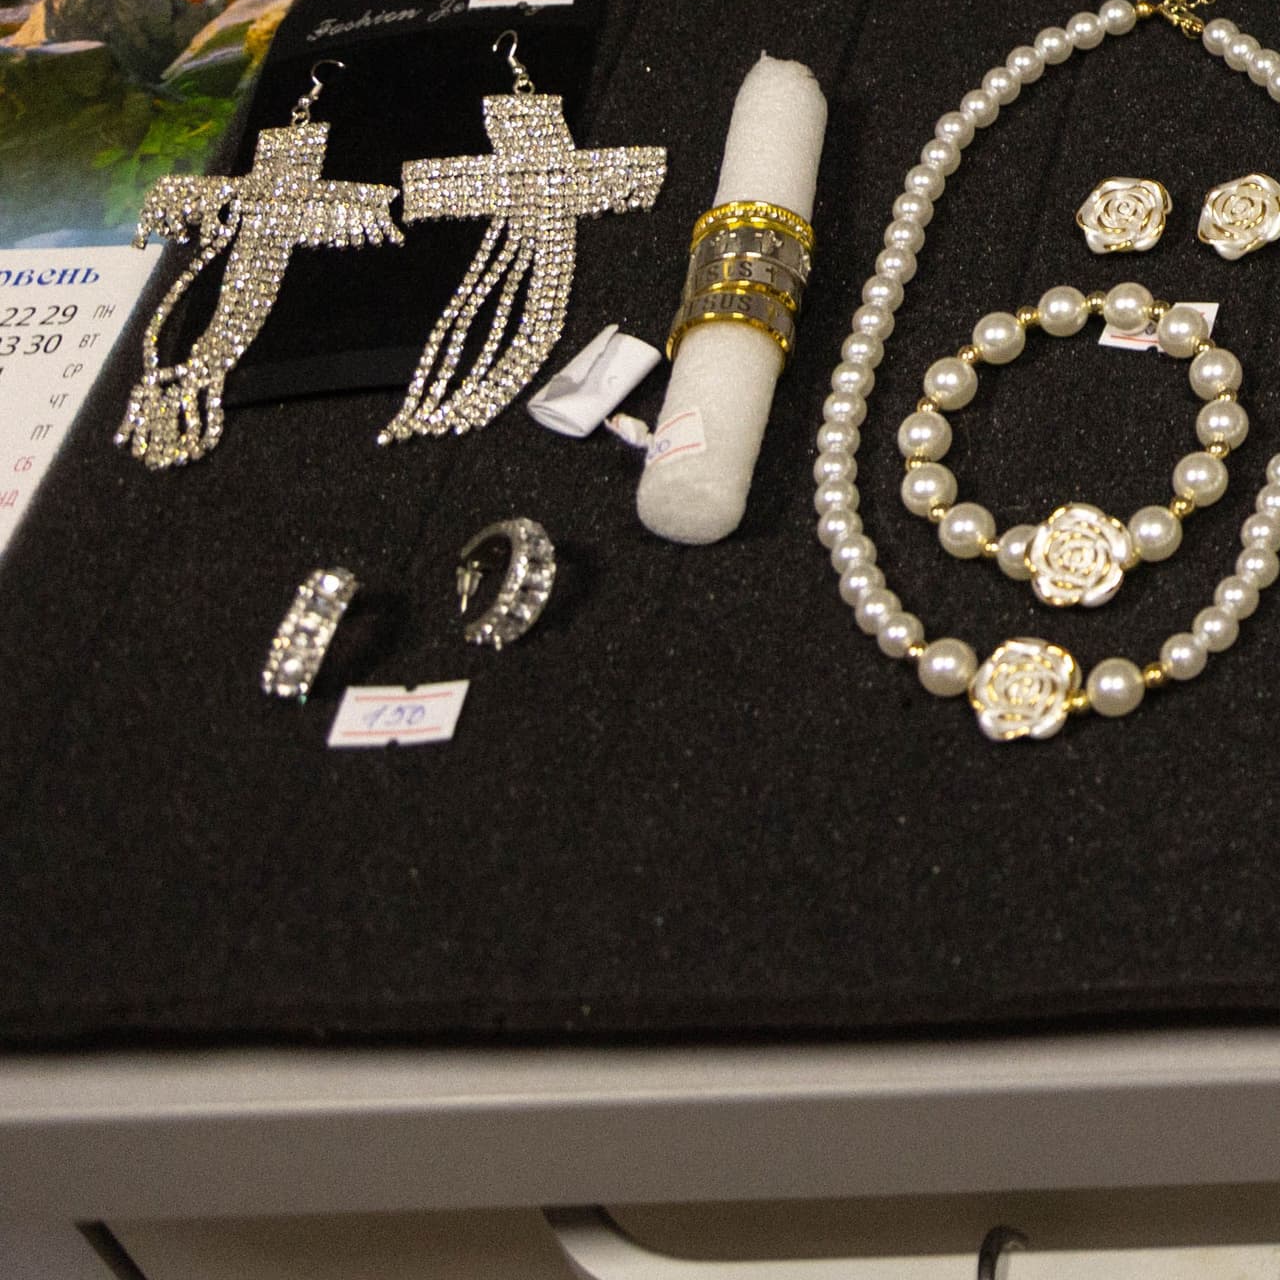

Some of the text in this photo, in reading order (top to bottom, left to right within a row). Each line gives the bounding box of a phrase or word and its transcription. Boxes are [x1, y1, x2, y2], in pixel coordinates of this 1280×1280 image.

[305, 6, 424, 43] Fashion
[693, 261, 754, 288] SUS
[38, 303, 79, 326] 29
[92, 303, 116, 320] ПН
[687, 293, 751, 317] SUS
[0, 332, 101, 357] 3 30 ВТ
[62, 362, 84, 379] СР
[50, 393, 69, 410] ЧТ
[30, 423, 53, 441] ПТ
[14, 455, 34, 473] СБ
